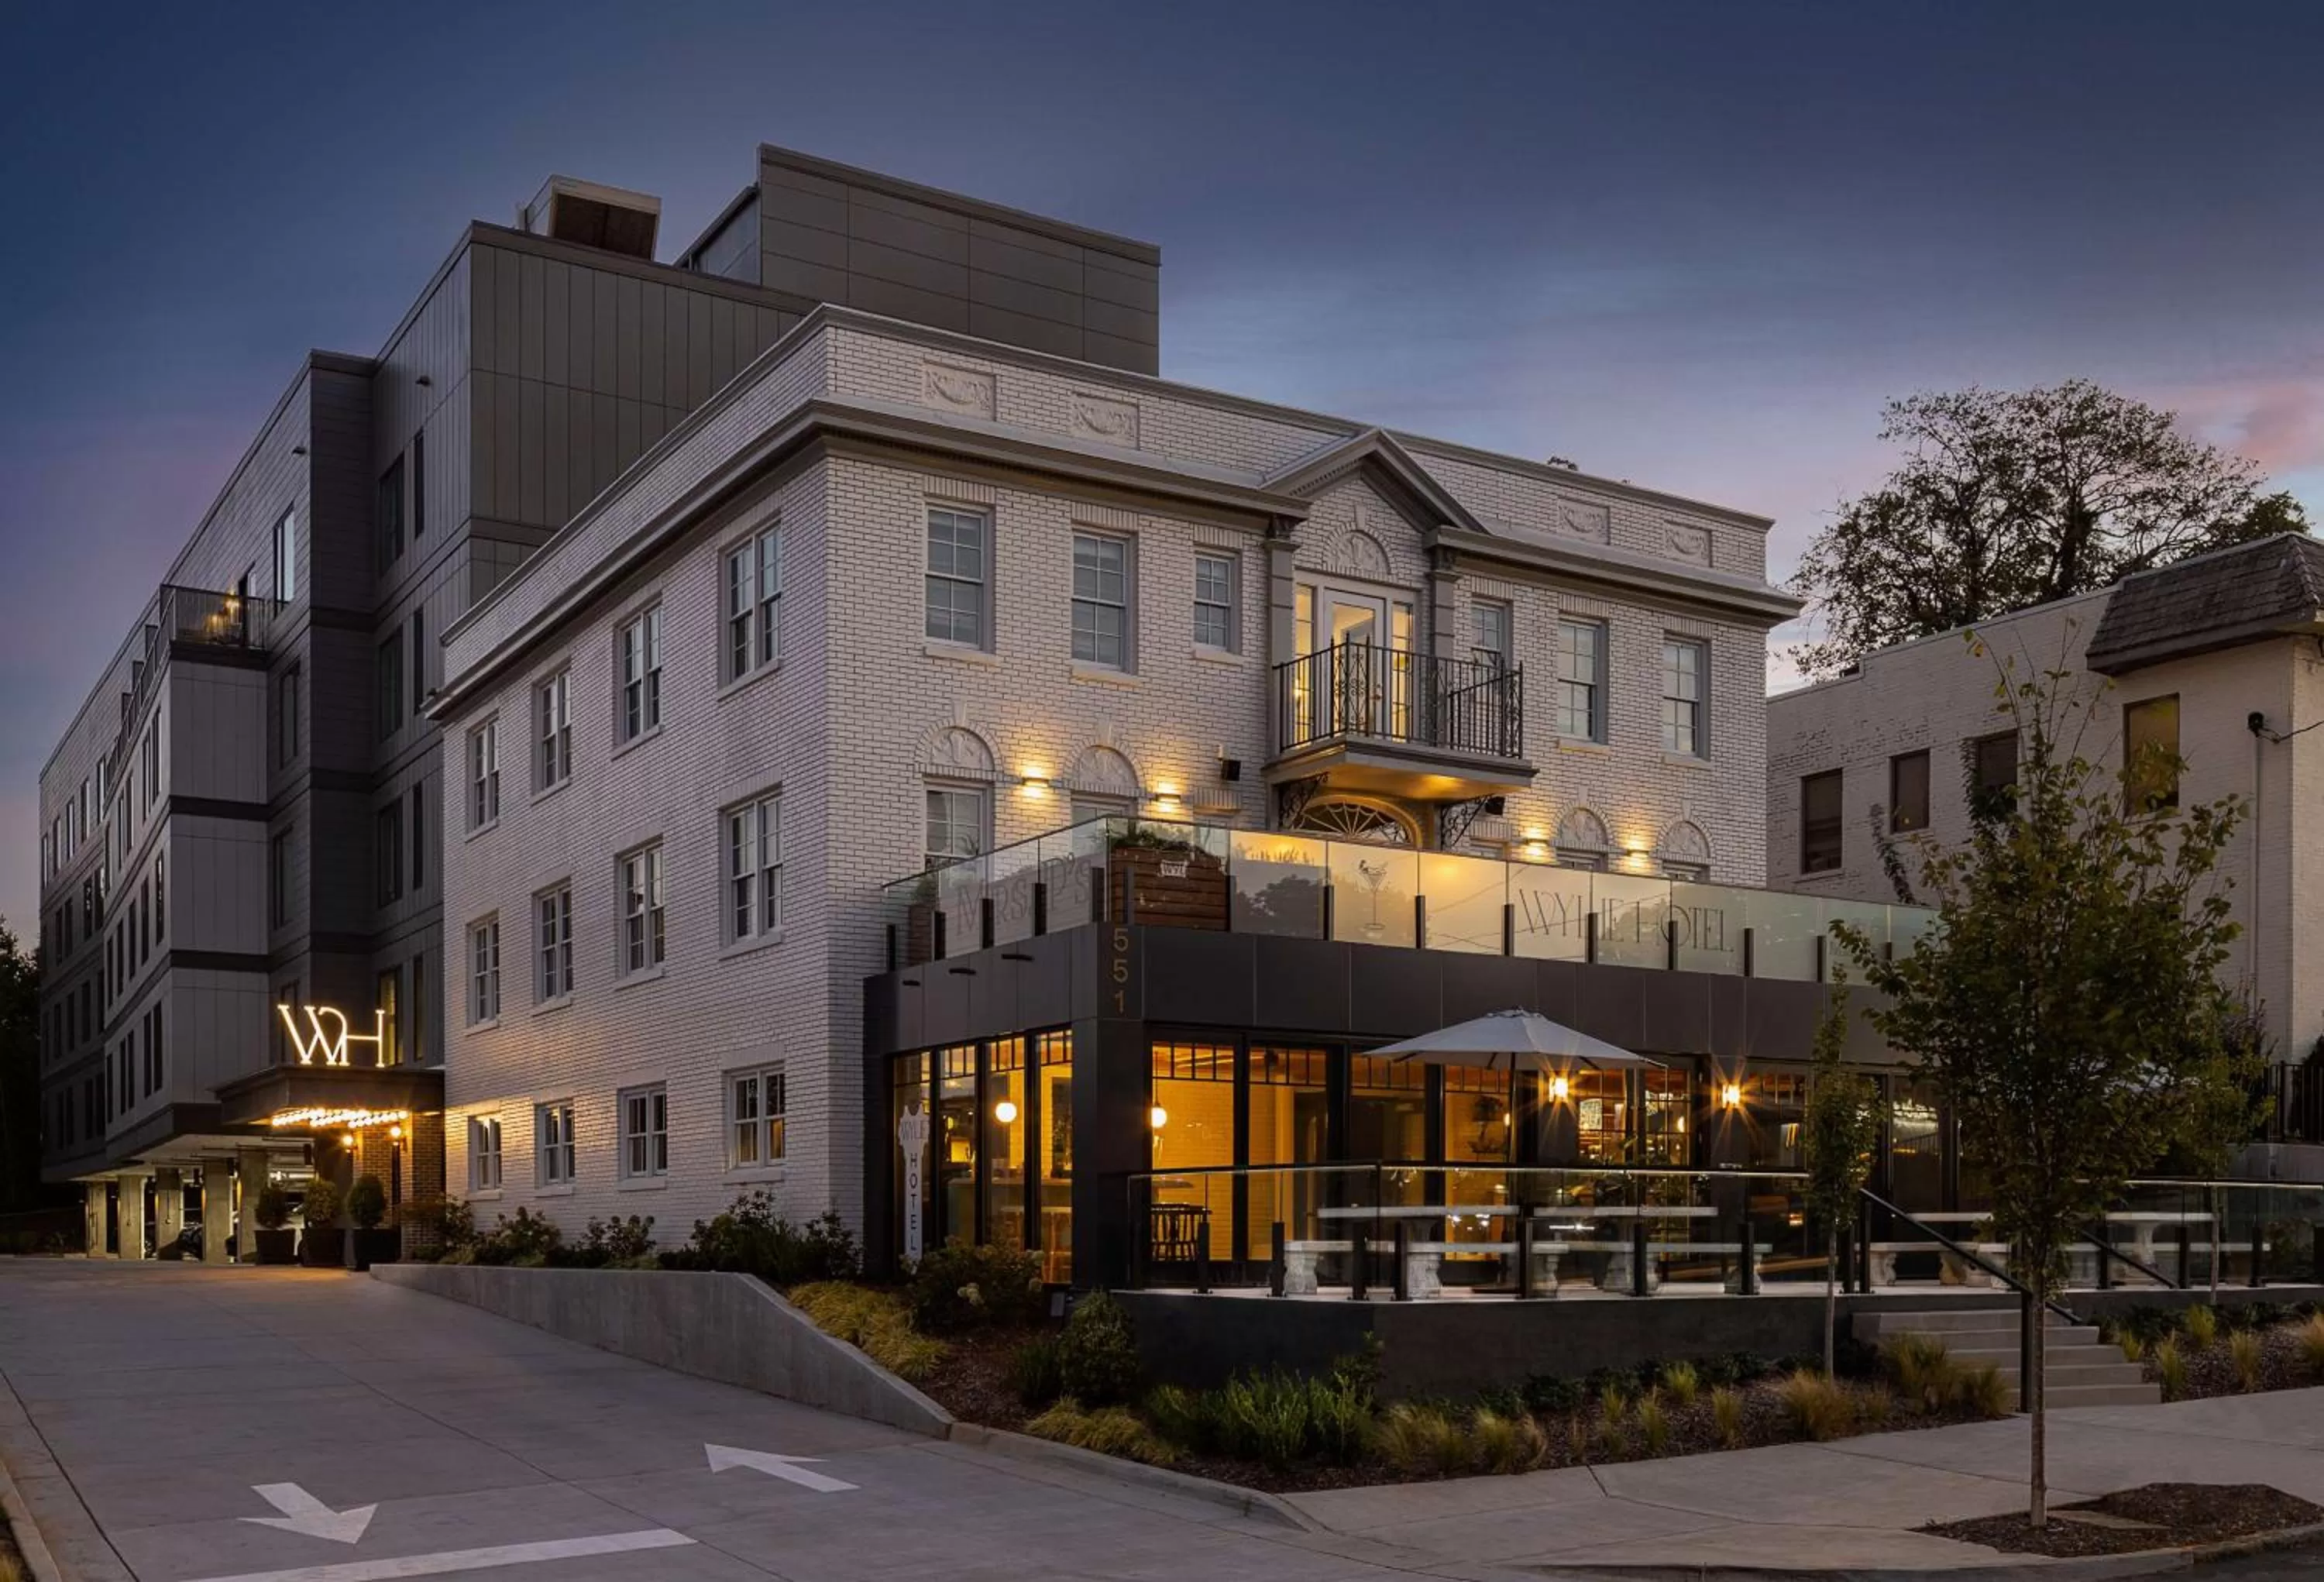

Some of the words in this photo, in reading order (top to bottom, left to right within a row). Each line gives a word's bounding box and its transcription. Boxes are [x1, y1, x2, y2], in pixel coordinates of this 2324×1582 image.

[1635, 900, 1734, 952] HOTEL
[1113, 927, 1129, 1013] 551
[908, 1153, 919, 1251] HOTEL
